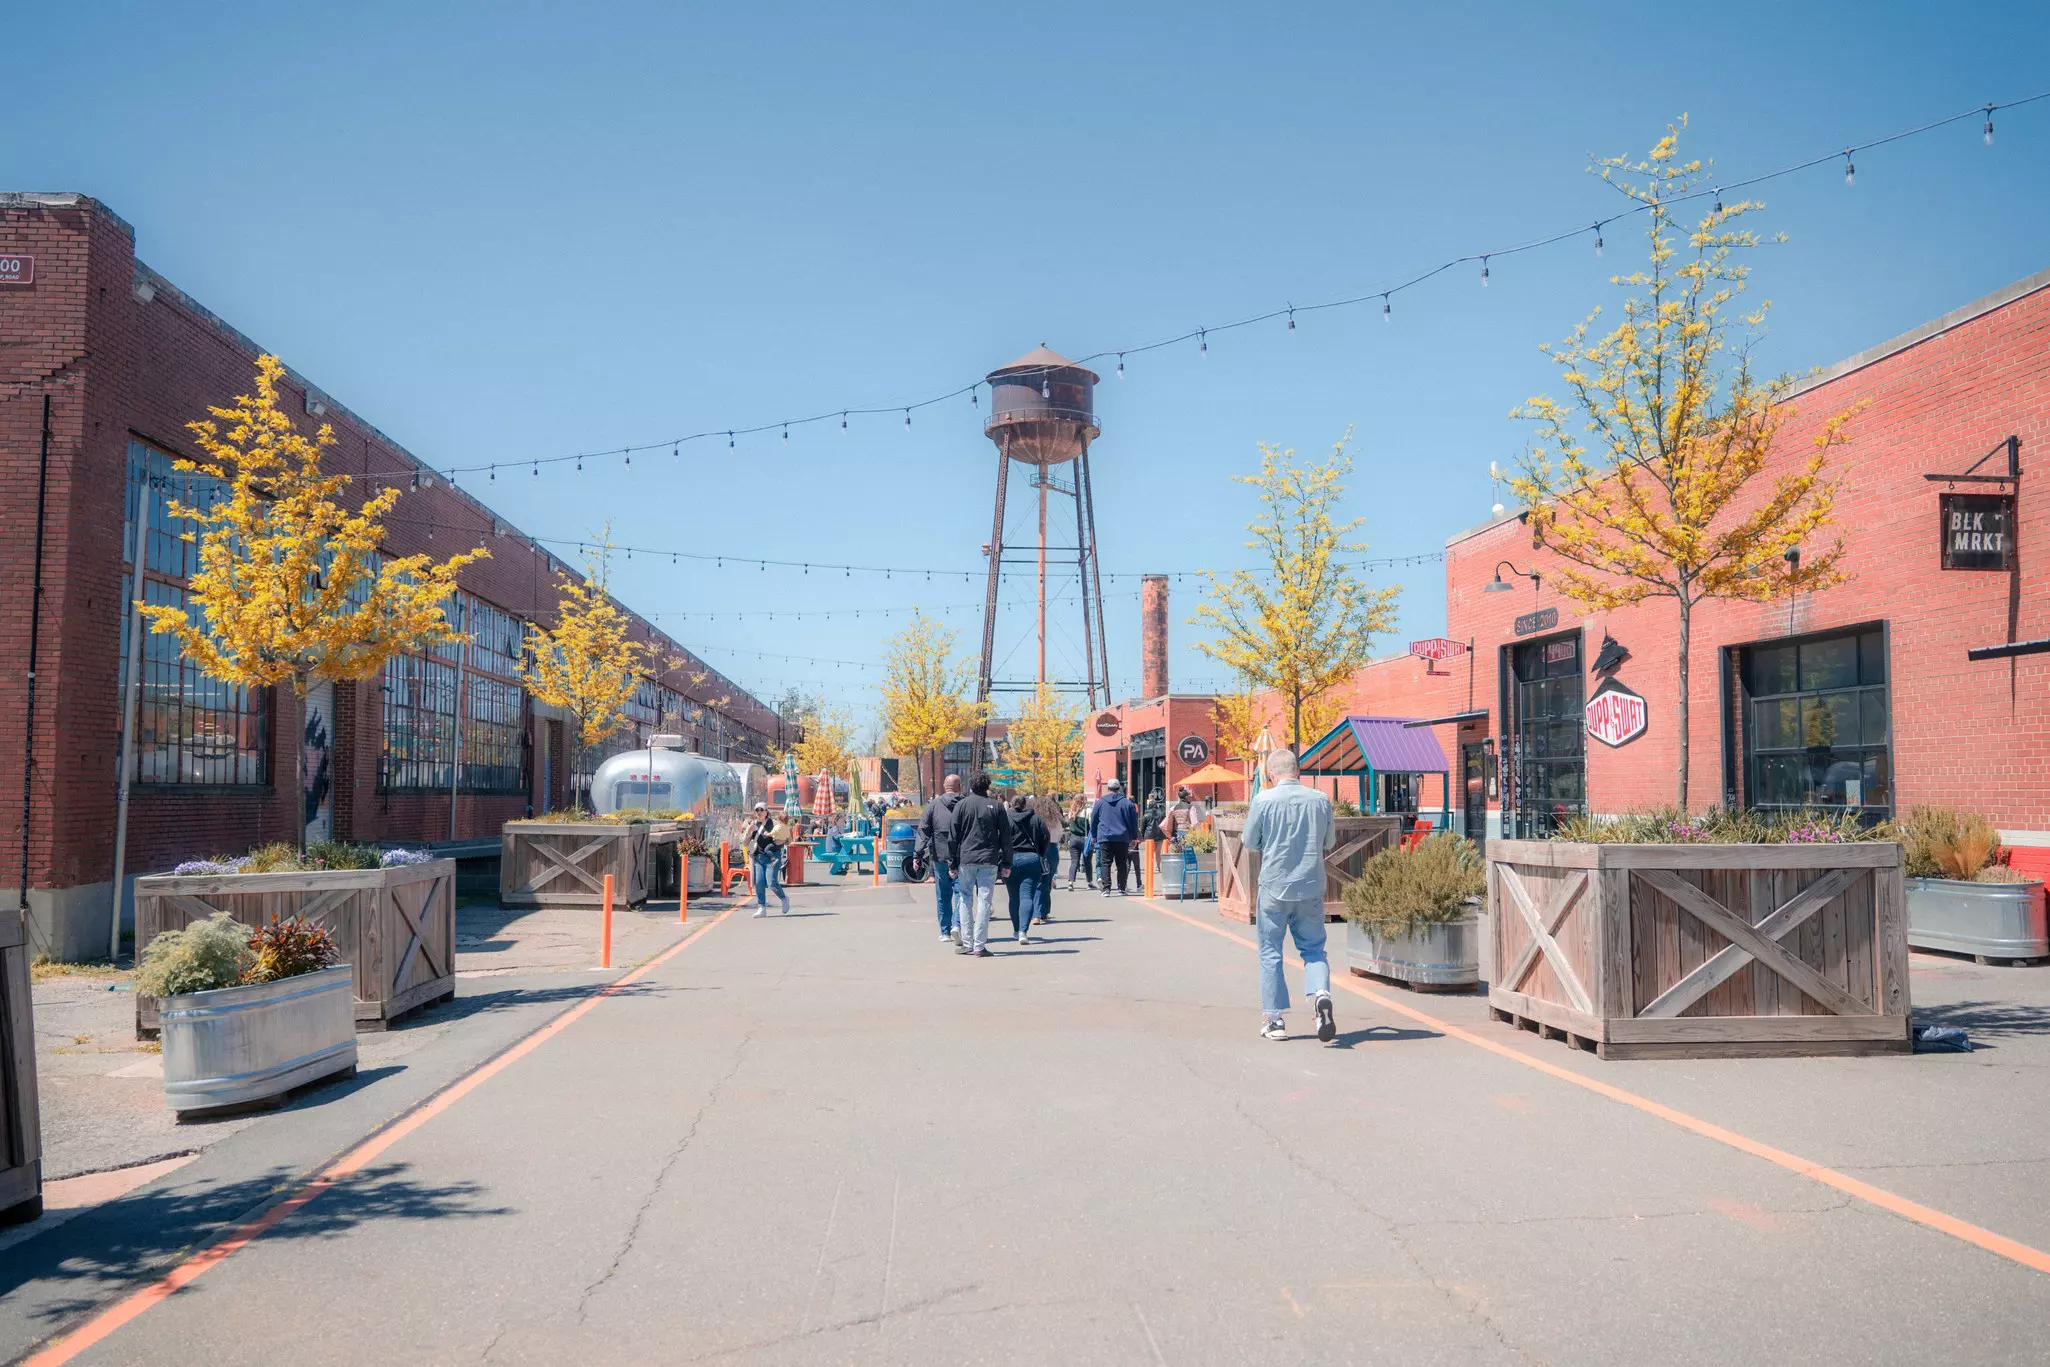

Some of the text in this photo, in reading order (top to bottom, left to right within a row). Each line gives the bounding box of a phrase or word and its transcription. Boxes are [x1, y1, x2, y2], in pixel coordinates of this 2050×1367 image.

[0, 259, 20, 272] 00
[1951, 512, 1984, 531] BLK
[1954, 532, 2004, 551] MRKT
[1516, 611, 1556, 633] SINCE 2010
[1184, 744, 1205, 759] PA
